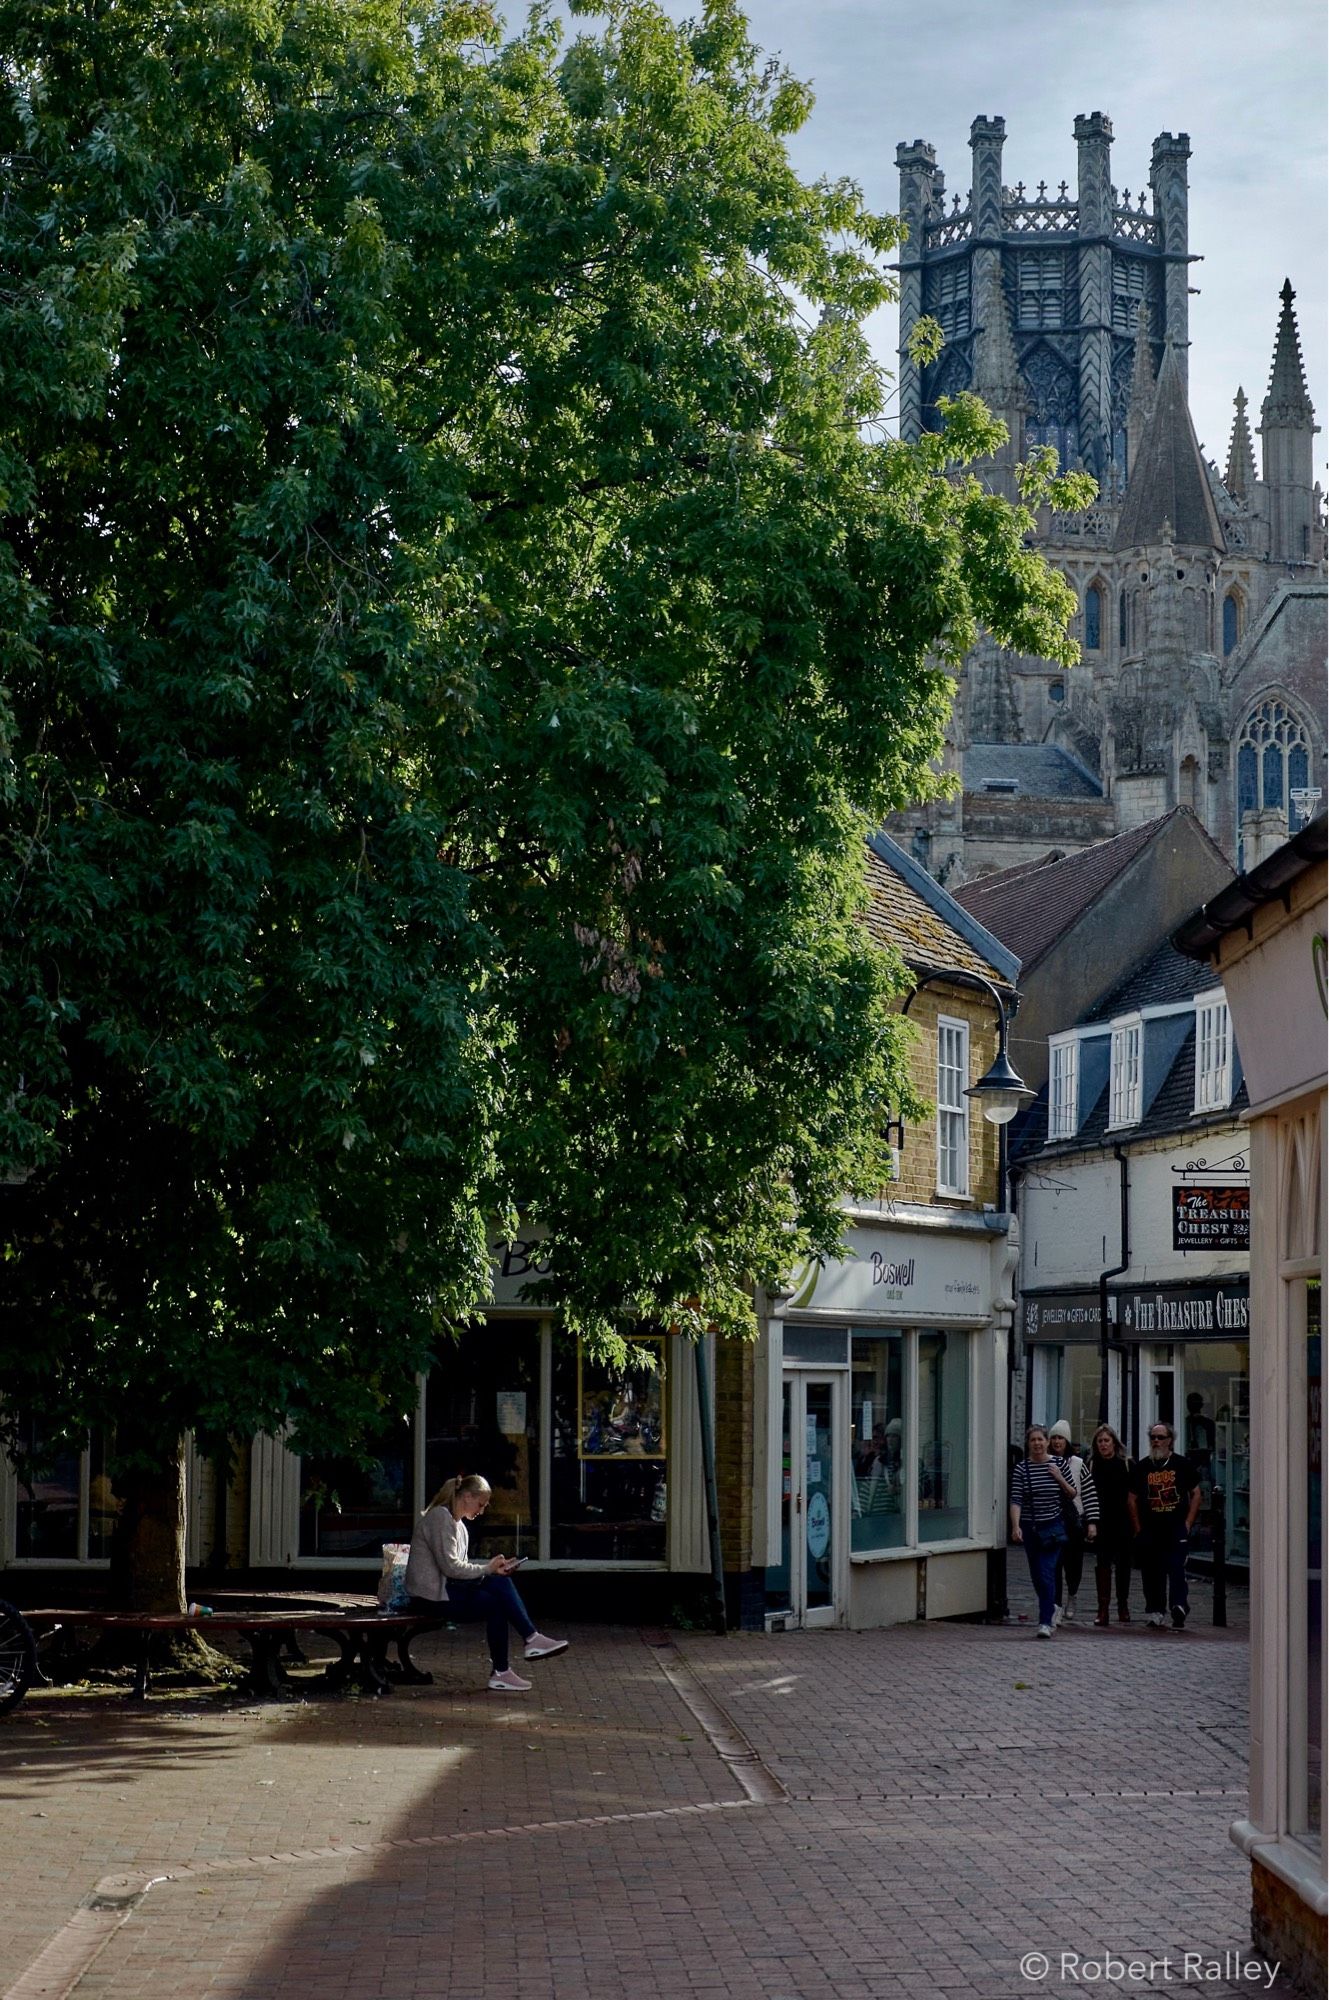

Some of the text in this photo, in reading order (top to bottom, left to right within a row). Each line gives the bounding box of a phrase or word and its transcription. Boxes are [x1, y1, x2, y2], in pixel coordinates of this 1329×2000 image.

[1187, 1196, 1208, 1208] The
[1176, 1206, 1250, 1219] TREASUR
[1177, 1221, 1229, 1234] CHEST
[1178, 1237, 1213, 1245] JEWELLERY
[1219, 1237, 1238, 1245] GIFTS
[870, 1251, 915, 1287] Boswell
[1041, 1307, 1102, 1327] JEWELLERY GIFTS CARD
[1133, 1296, 1155, 1331] THE
[1156, 1295, 1213, 1331] TREASURE
